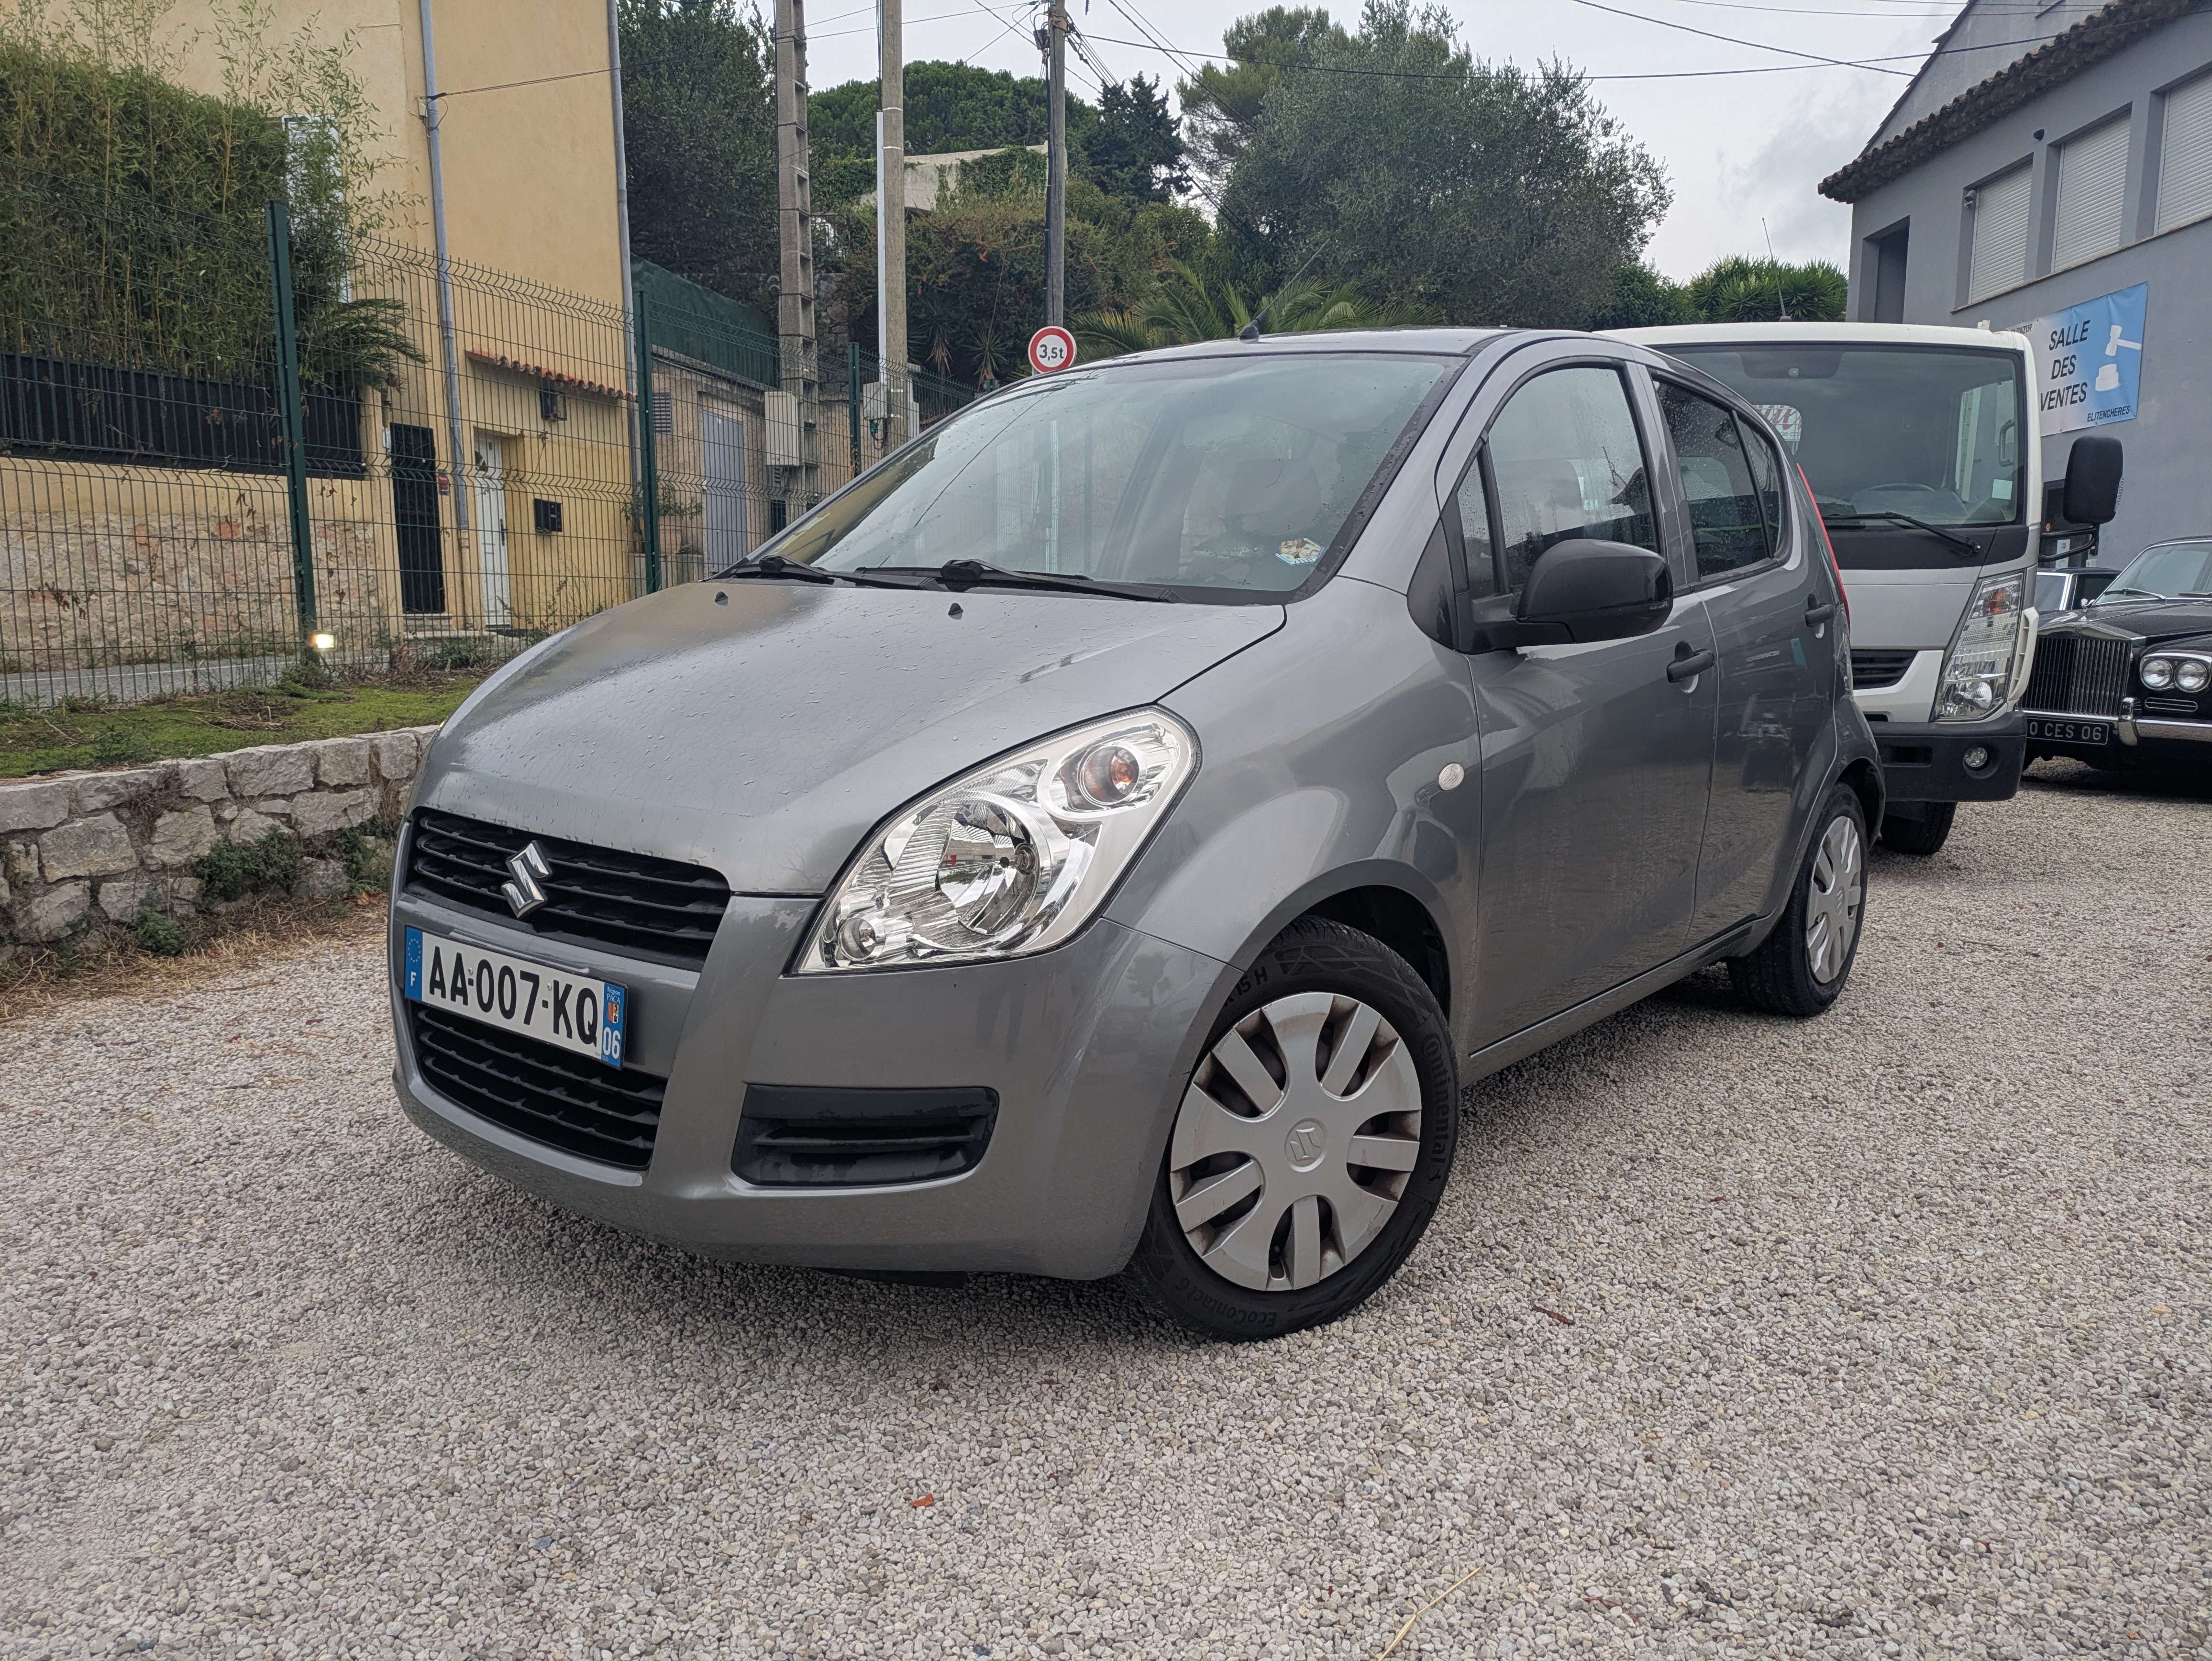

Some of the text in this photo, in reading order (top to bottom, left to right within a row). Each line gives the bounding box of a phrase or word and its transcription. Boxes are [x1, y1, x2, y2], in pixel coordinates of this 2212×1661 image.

[2049, 320, 2090, 351] SALLE
[1039, 344, 1064, 361] 3,5t
[2051, 354, 2077, 380] DES
[2040, 382, 2088, 411] VENTES
[2087, 406, 2130, 422] ELITENCHERES
[2045, 723, 2074, 738] CES
[2081, 726, 2102, 741] 06
[410, 971, 417, 987] F
[1254, 966, 1268, 985] H
[607, 993, 620, 1005] PACA
[603, 1026, 621, 1060] 06
[1423, 1032, 1451, 1163] Continental
[1174, 1276, 1278, 1327] EcoContact 6
